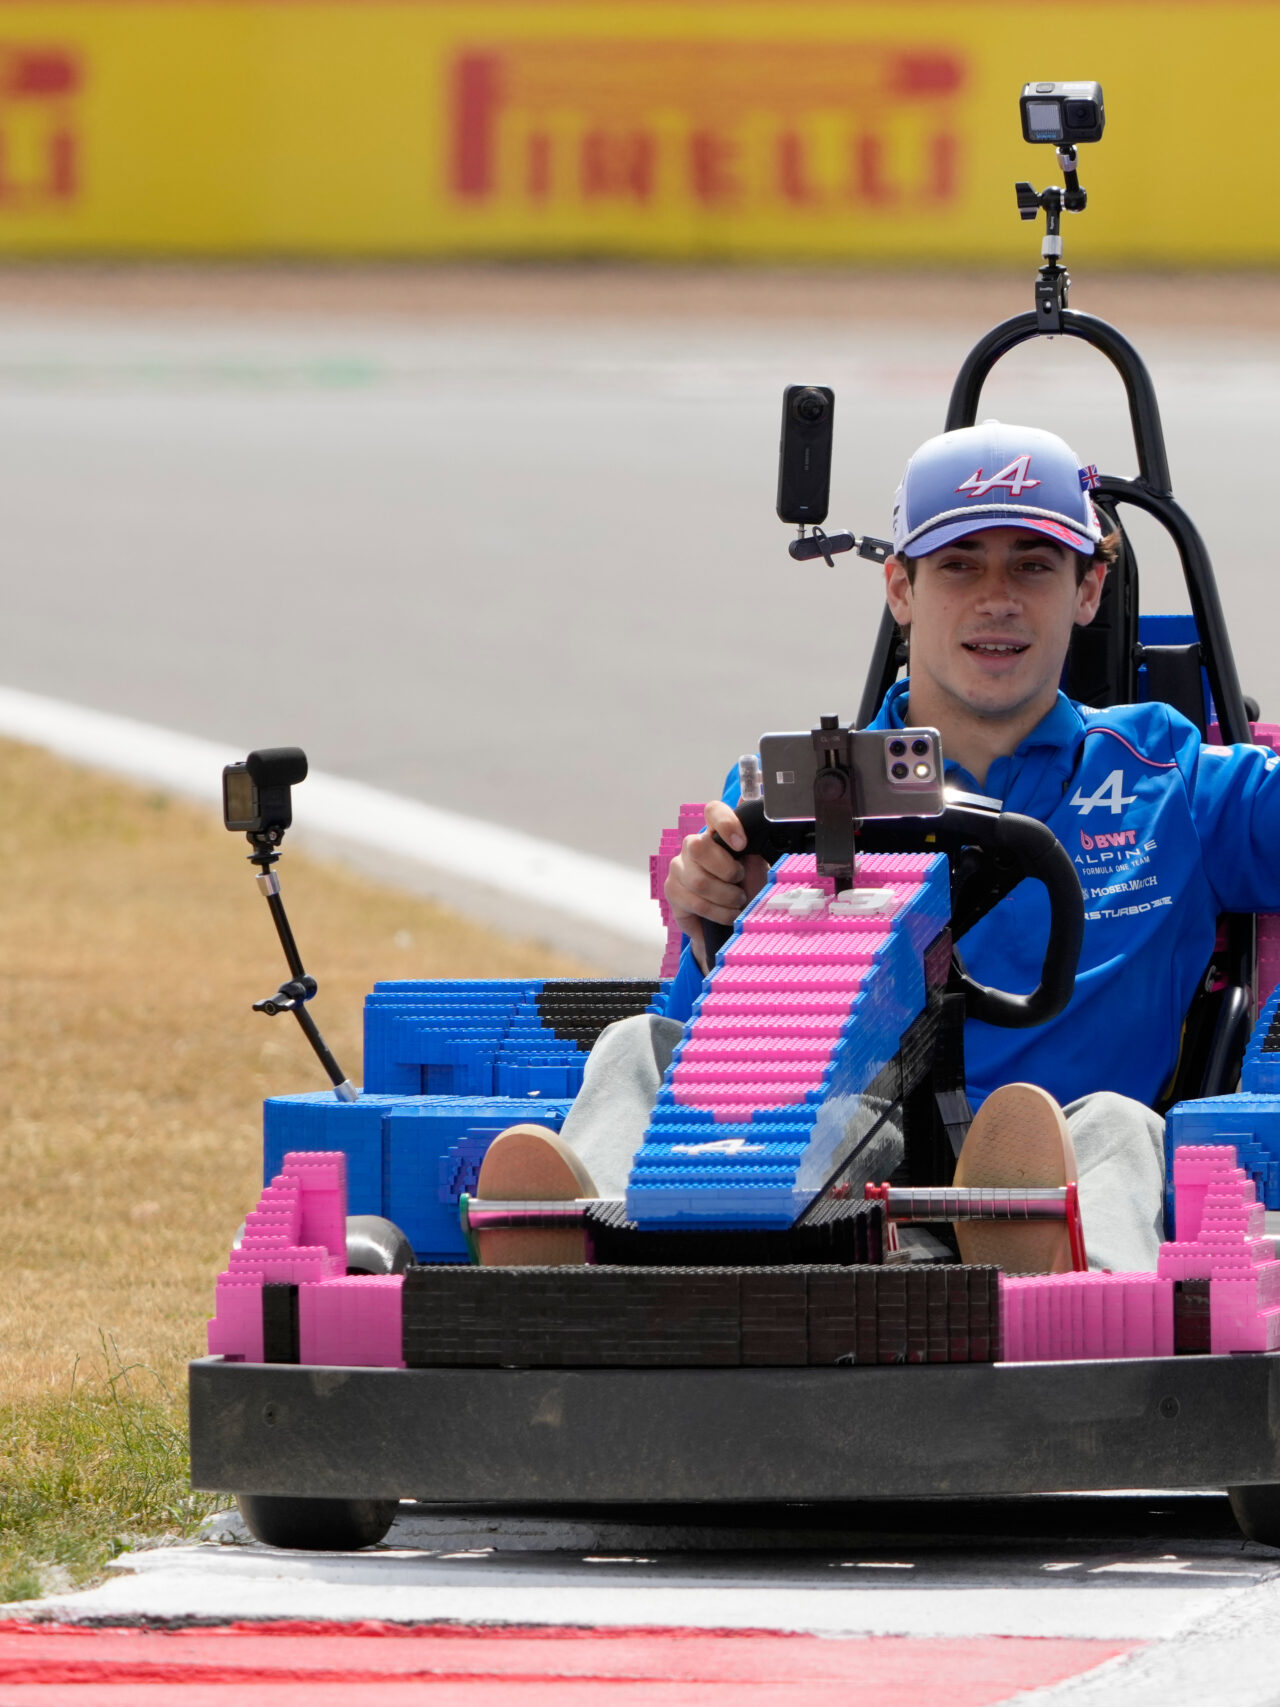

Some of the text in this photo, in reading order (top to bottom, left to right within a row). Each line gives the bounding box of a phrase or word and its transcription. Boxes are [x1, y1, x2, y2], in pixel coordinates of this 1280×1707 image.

[446, 40, 968, 208] PIRELLI
[1094, 829, 1137, 849] BWT
[1074, 839, 1158, 864] ALPINE
[1082, 856, 1151, 876] FORMULA ONE TEAM
